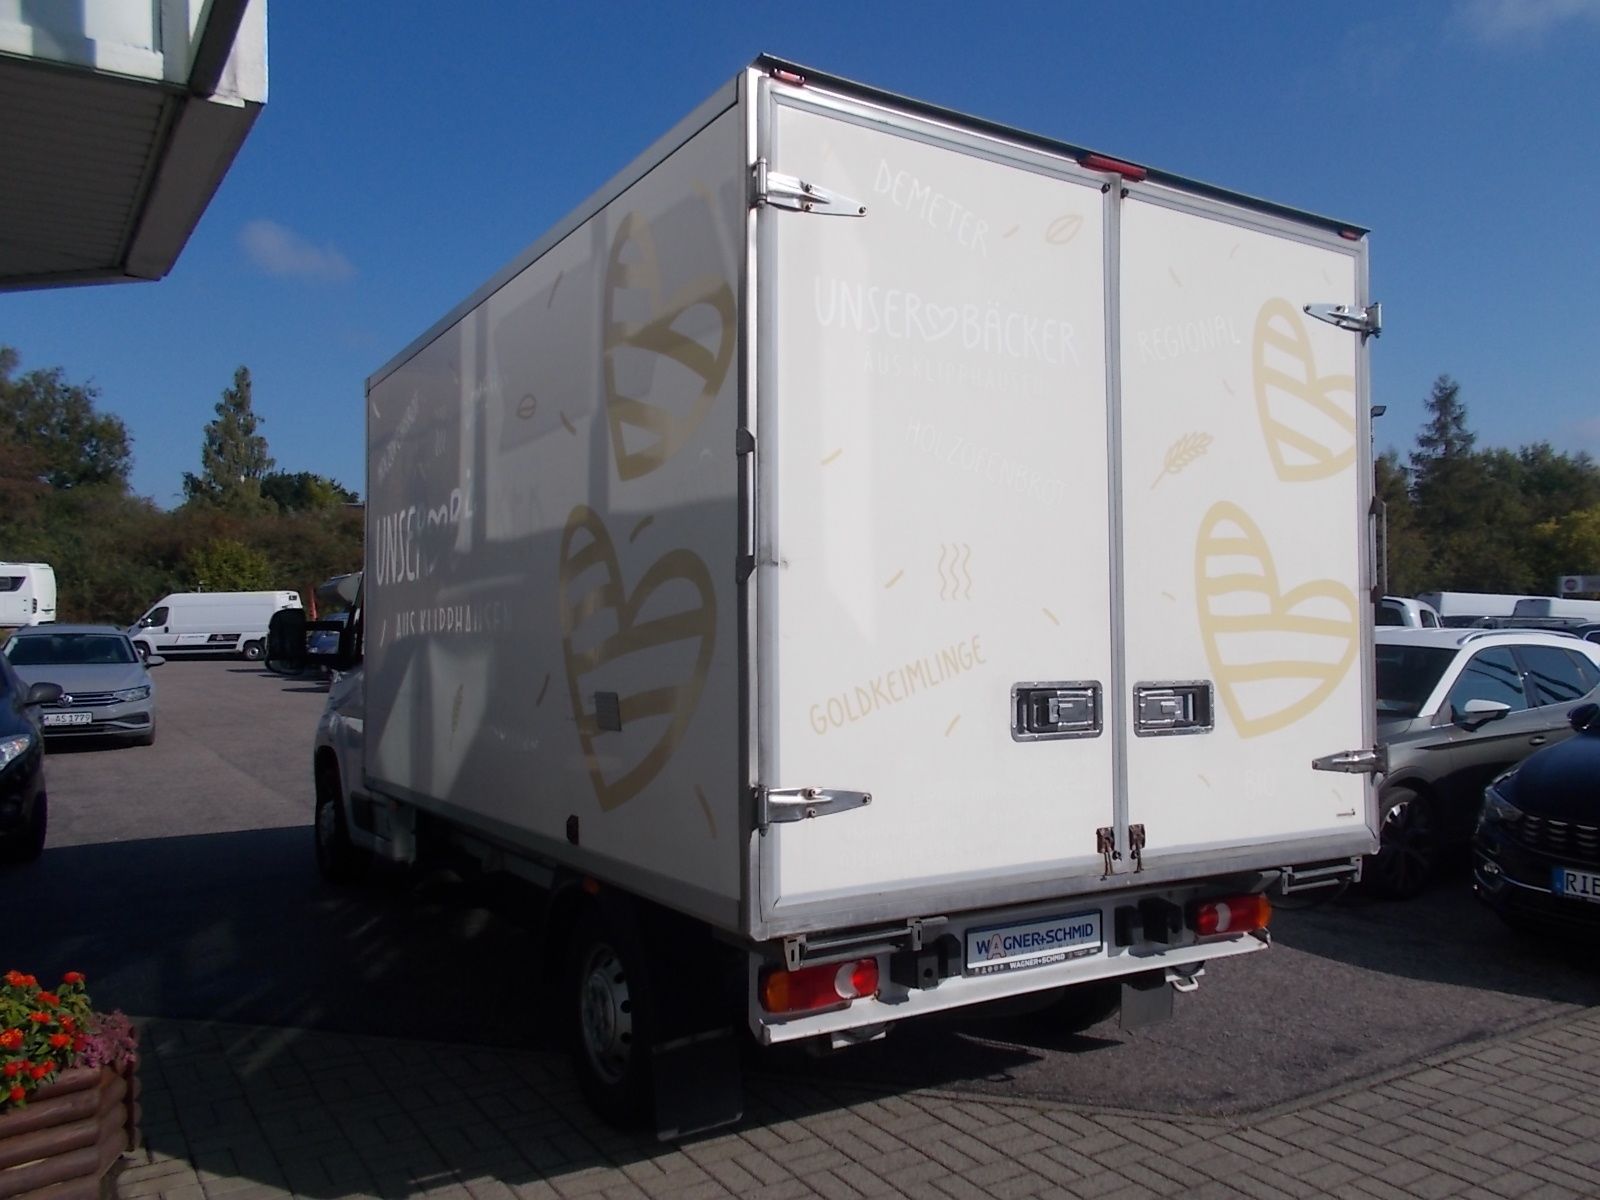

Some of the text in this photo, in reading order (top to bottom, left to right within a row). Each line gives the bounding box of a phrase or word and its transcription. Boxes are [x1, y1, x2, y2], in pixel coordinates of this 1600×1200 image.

[873, 157, 989, 257] DEMETER
[814, 275, 1081, 367] UNSER BÄCKER
[1137, 315, 1241, 363] REGIONAL
[809, 634, 987, 736] GOLDKEIMLINGE
